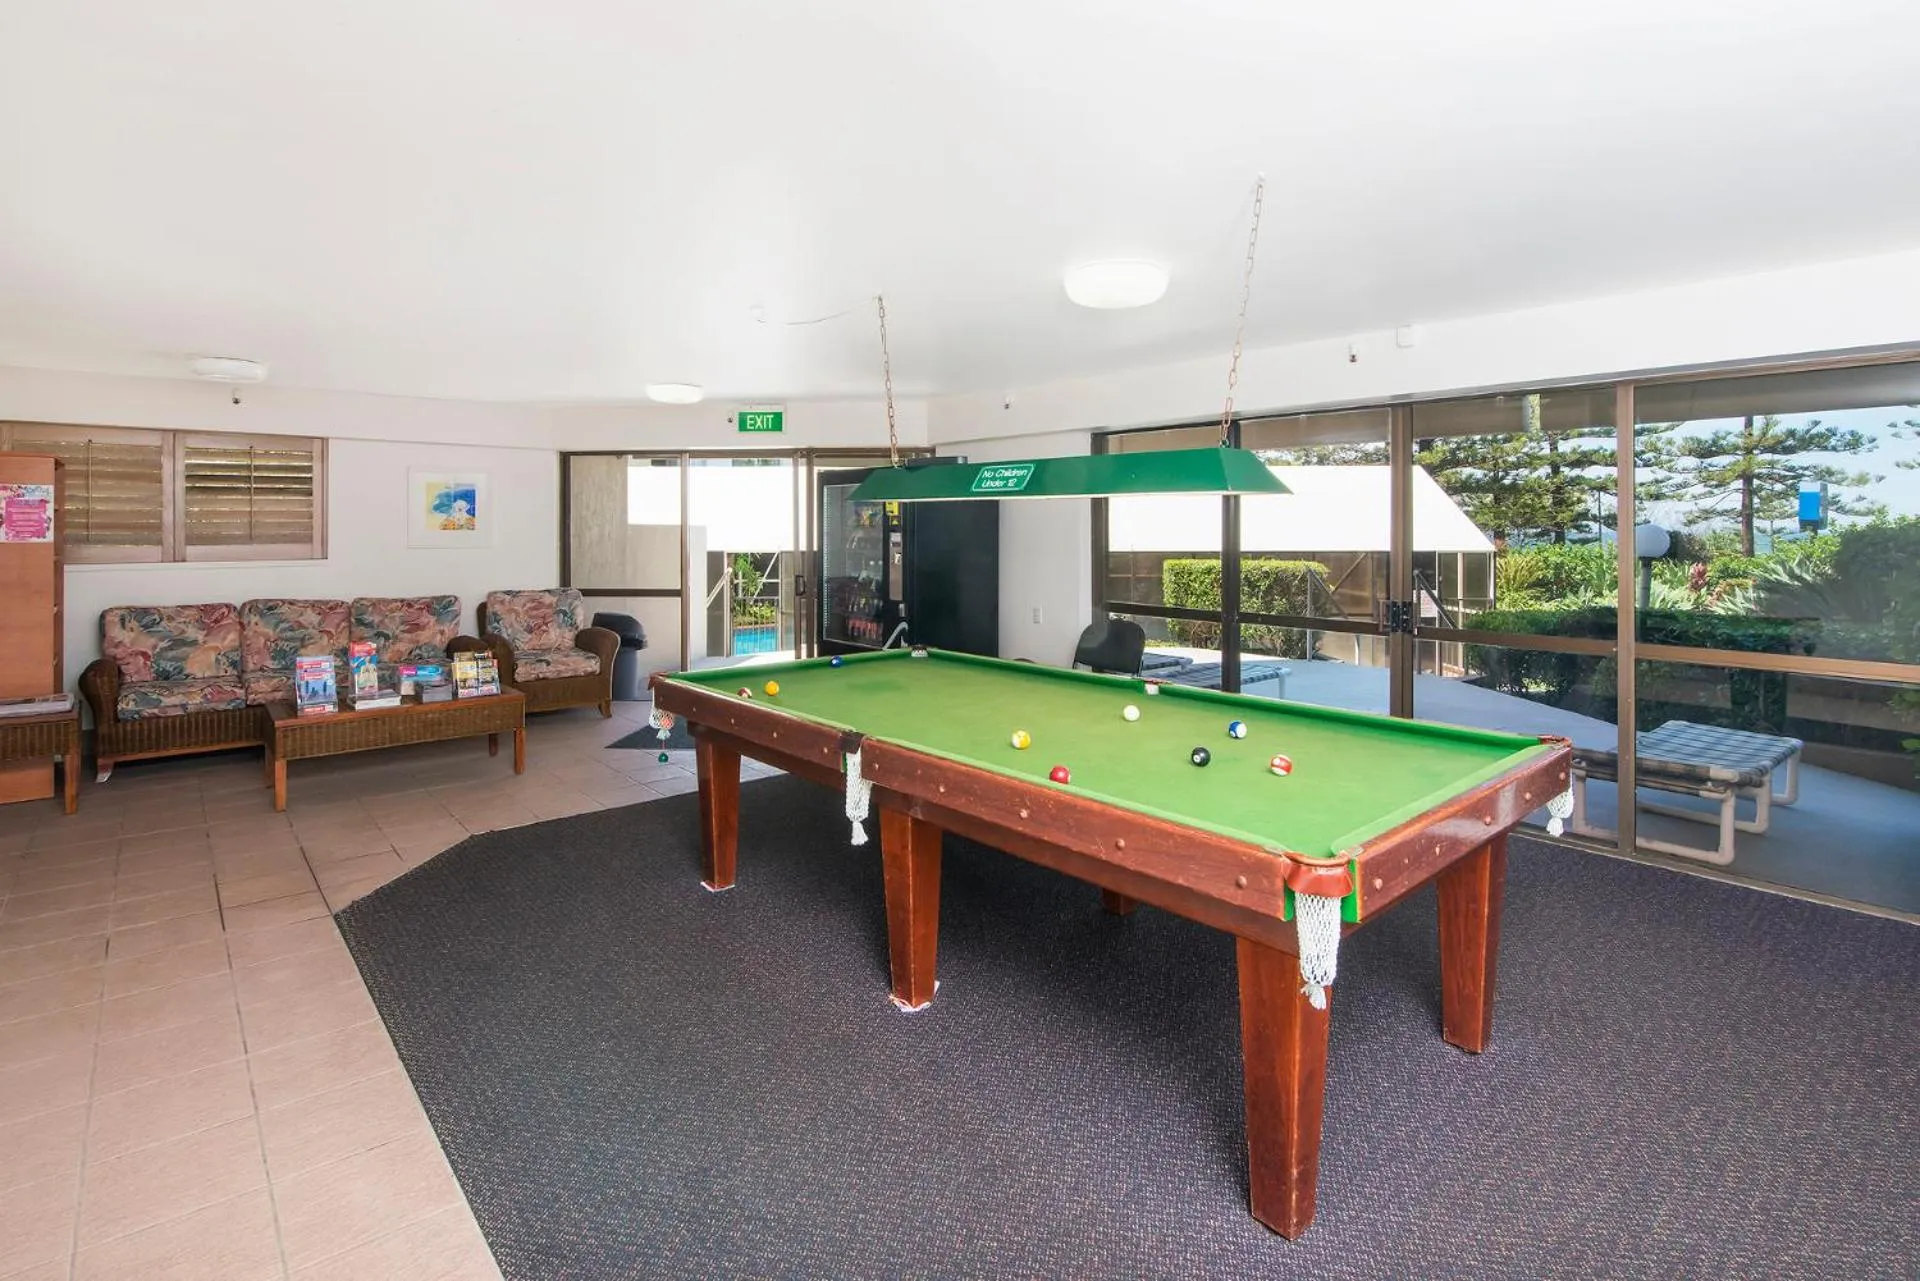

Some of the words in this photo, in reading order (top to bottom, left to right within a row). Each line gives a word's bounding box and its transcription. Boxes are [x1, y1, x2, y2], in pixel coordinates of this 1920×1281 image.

[747, 415, 774, 430] EXIT
[982, 470, 994, 479] No
[996, 469, 1028, 478] Children
[981, 479, 1006, 488] Under
